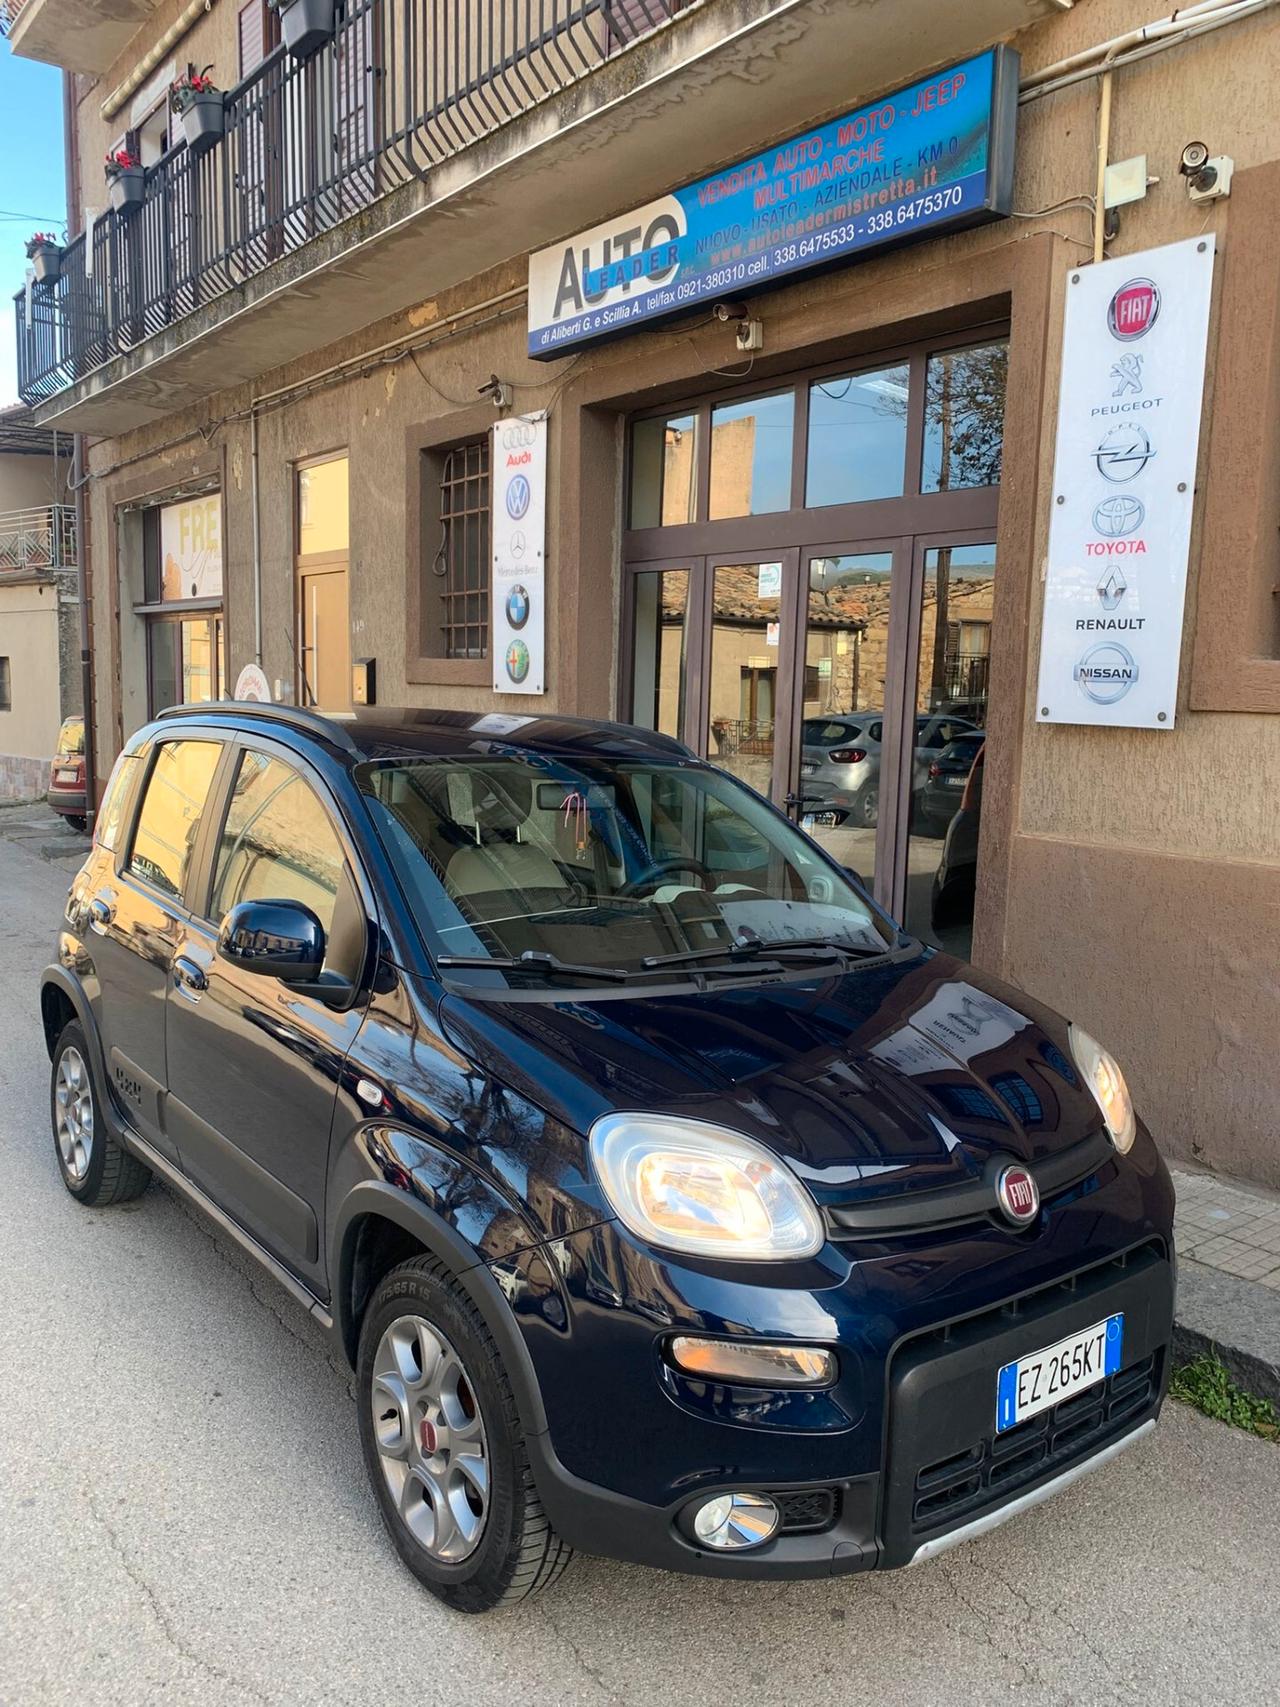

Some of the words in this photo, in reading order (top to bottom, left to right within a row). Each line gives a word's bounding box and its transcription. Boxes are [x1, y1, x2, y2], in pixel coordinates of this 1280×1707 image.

[697, 162, 766, 207] VENDITA
[773, 136, 823, 177] AUTO
[837, 104, 895, 148] MOTO
[911, 72, 966, 117] JEEP
[754, 137, 885, 209] MULTIMARCHE
[695, 224, 741, 255] NUOVO
[752, 202, 798, 231] USATO
[814, 157, 903, 206] AZIENDALE
[918, 142, 943, 168] KM
[541, 331, 550, 345] di
[551, 320, 581, 341] Aliberti
[583, 316, 593, 332] G.
[595, 316, 600, 328] e
[603, 306, 630, 325] Scillia
[631, 301, 642, 317] A.
[647, 290, 675, 311] tel/fax
[677, 262, 745, 301] 0921-380310
[748, 255, 770, 276] cell.
[774, 224, 855, 267] 338.6475533
[867, 186, 962, 234] 338.6475370
[552, 214, 680, 319] AUTO
[583, 244, 680, 294] LEADER
[1119, 294, 1151, 326] FIAT
[1091, 398, 1164, 417] PEUGEOT
[506, 450, 532, 467] Audi
[1085, 540, 1147, 556] TOYOTA
[1076, 618, 1146, 630] RENAULT
[1079, 668, 1133, 678] NISSAN
[1008, 1180, 1031, 1208] FIAT
[1018, 1363, 1042, 1409] EZ
[1048, 1333, 1105, 1395] 265KT
